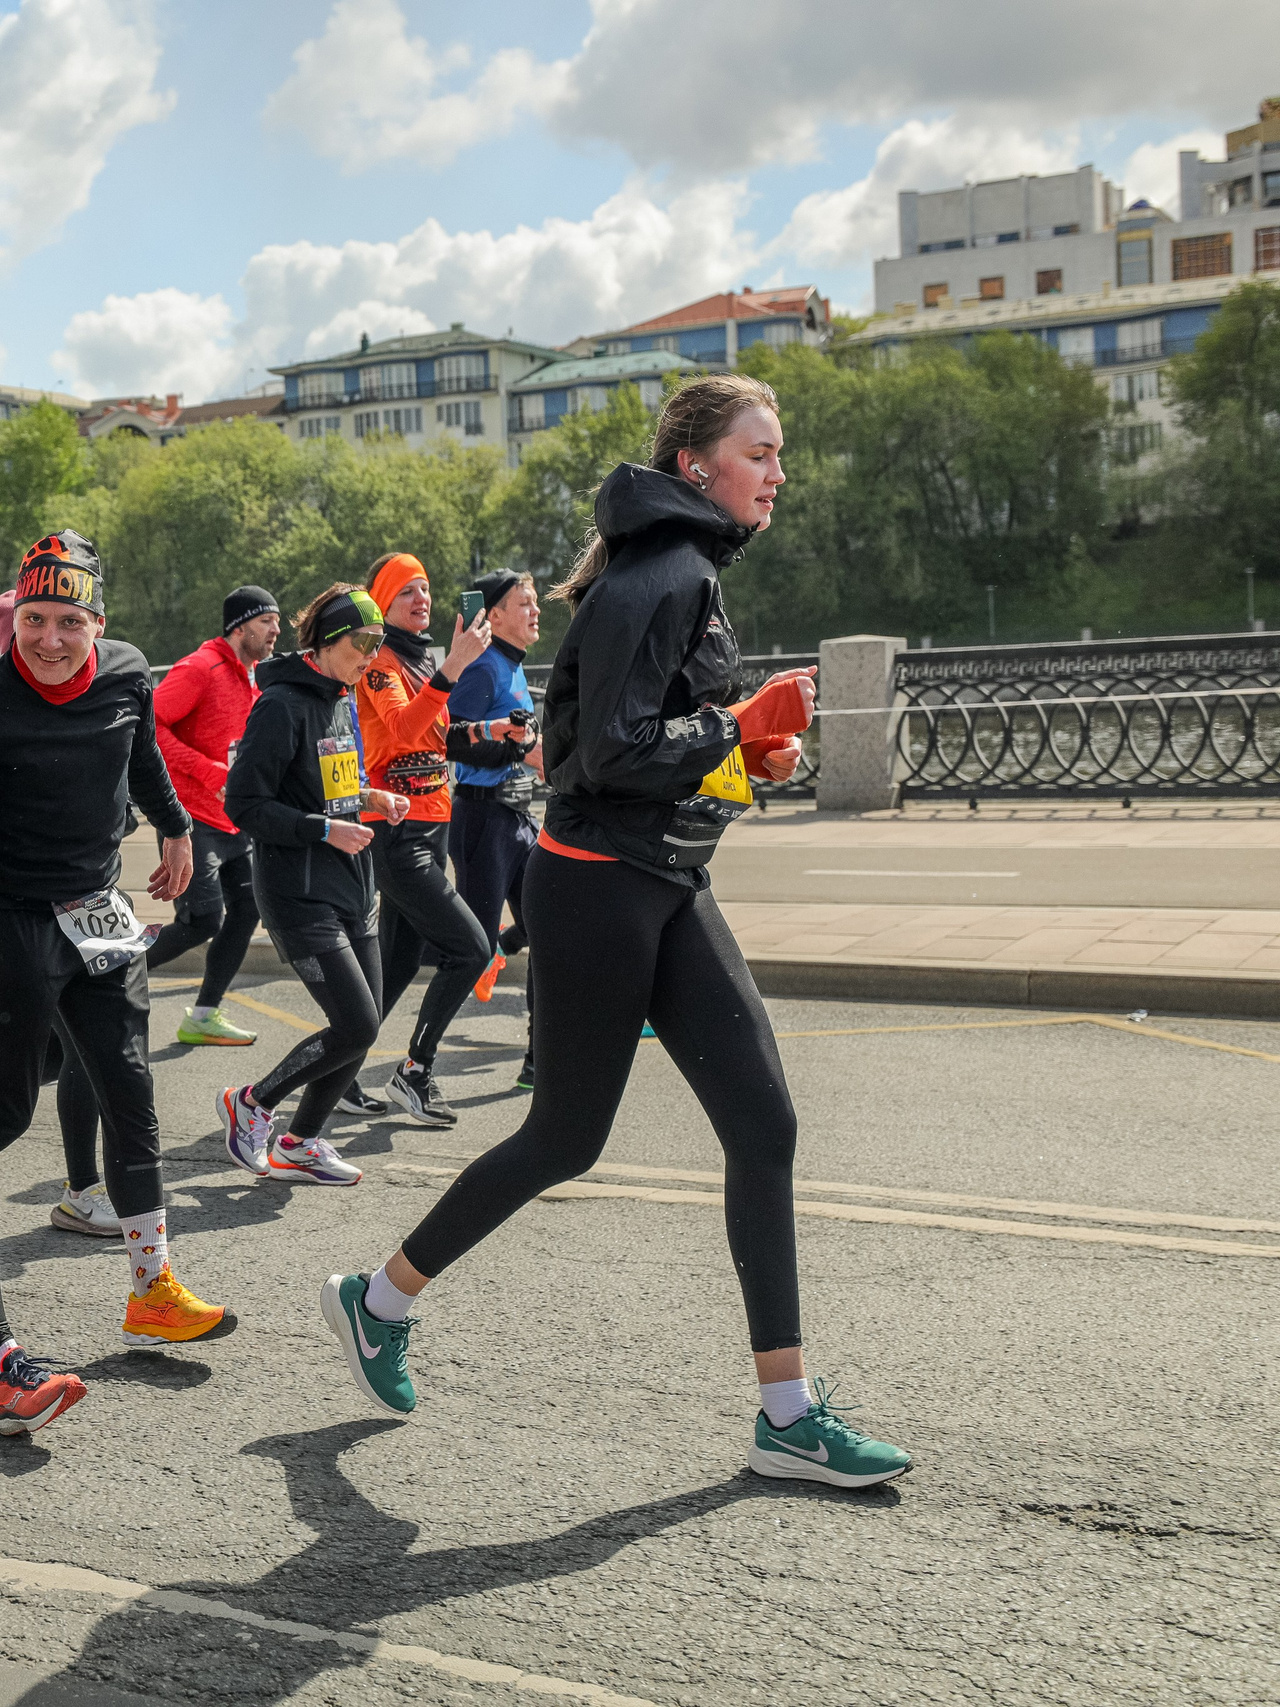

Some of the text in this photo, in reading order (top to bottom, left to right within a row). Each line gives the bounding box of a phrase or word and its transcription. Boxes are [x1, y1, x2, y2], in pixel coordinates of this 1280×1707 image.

[332, 759, 358, 783] 6112
[332, 799, 341, 812] E
[95, 955, 108, 970] G
